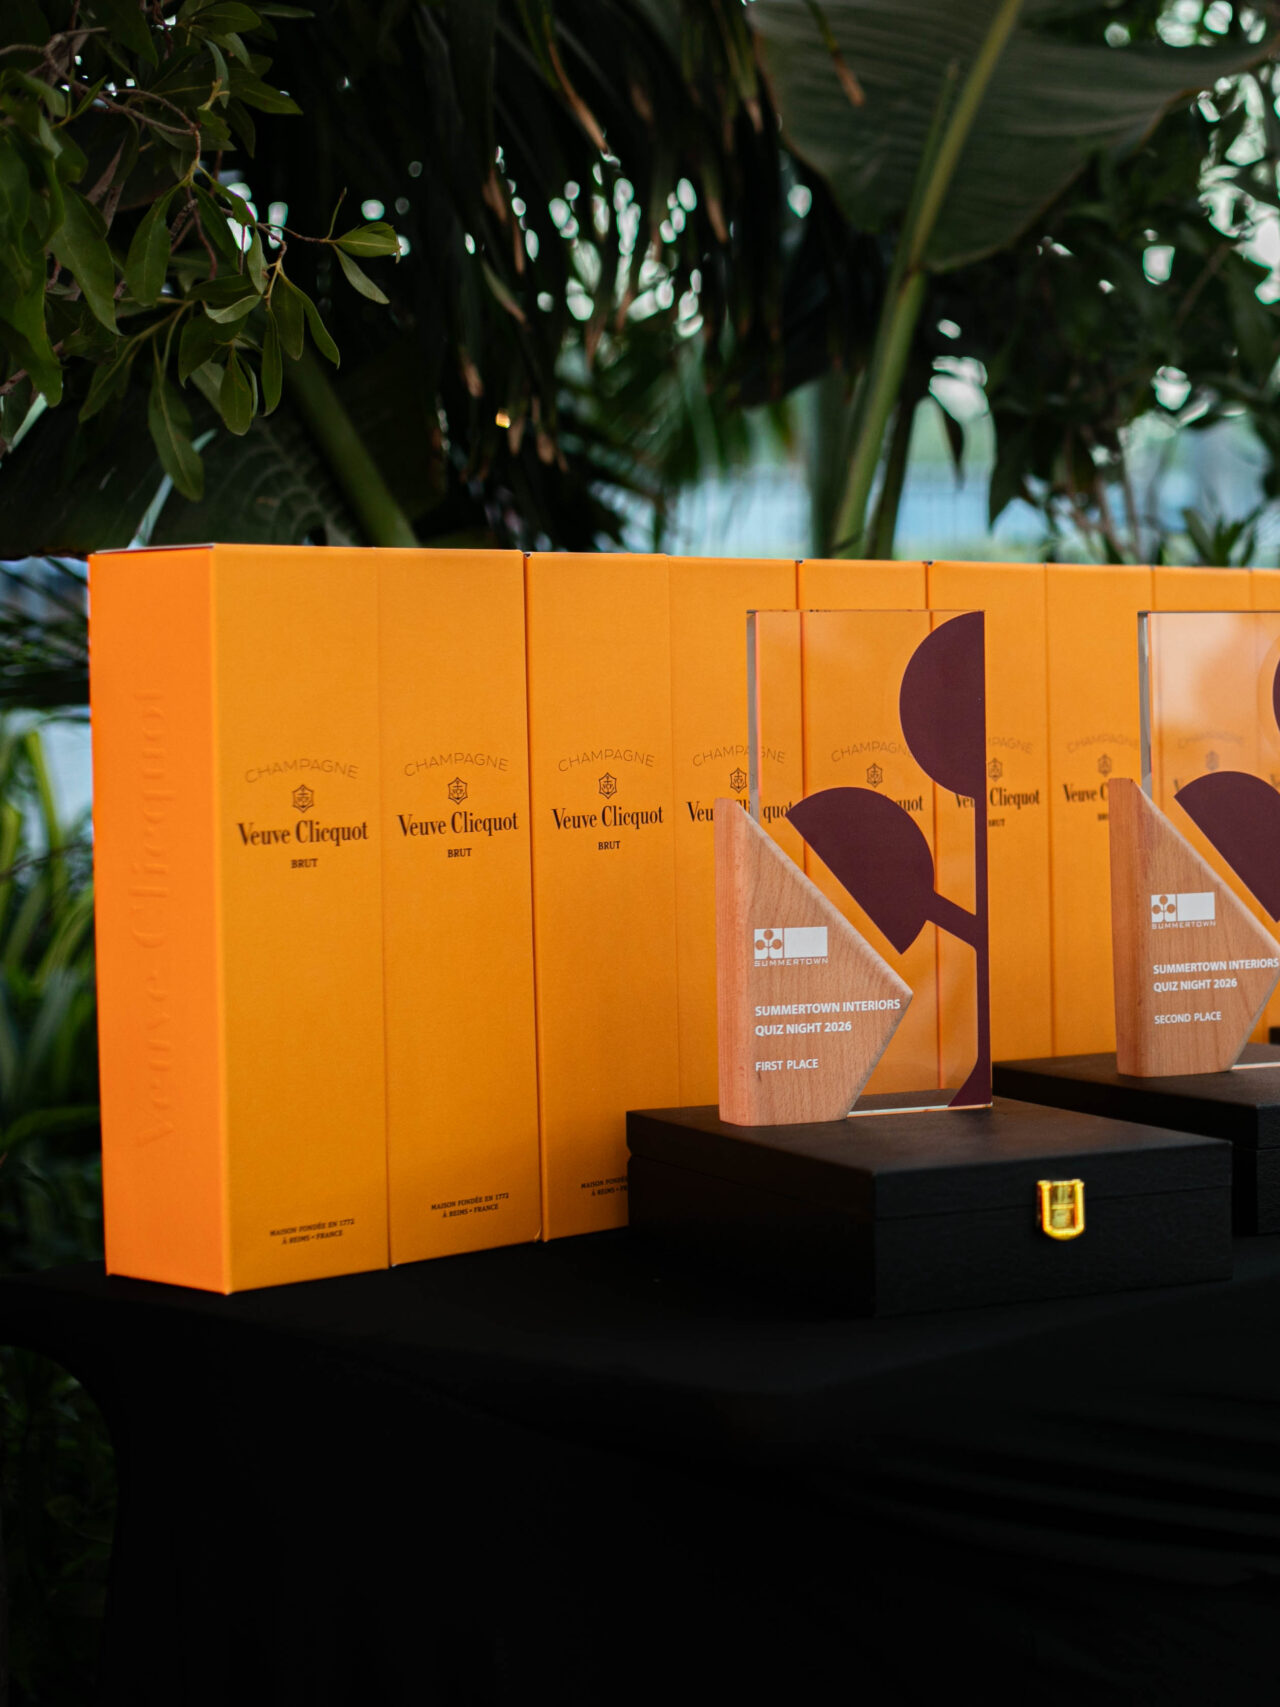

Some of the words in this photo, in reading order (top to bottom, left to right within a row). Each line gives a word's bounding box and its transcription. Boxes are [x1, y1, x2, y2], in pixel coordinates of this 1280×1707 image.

[831, 741, 912, 762] CHAMPAGN
[404, 752, 509, 776] CHAMPAGNE
[558, 749, 655, 772] CHAMPAGNE
[245, 758, 360, 783] CHAMPAGNE
[552, 808, 597, 830] Veuve
[601, 805, 664, 830] Clicquot
[686, 801, 714, 822] Veu
[397, 814, 446, 837] Veuve
[451, 811, 519, 837] Clicquot
[237, 822, 290, 846] Veuve
[296, 820, 368, 847] Clicquot
[447, 848, 472, 858] BRUT
[598, 840, 621, 850] BRUT
[291, 858, 318, 869] BRUT
[1151, 920, 1216, 930] SUMMERTOWN
[754, 958, 829, 967] SUMMERTOWN
[1153, 961, 1226, 975] SUMMERTOWN
[1229, 958, 1279, 970] INTERIORS
[1153, 981, 1178, 993] QUIZ
[1180, 979, 1211, 990] NIGHT
[1213, 978, 1238, 988] 2026
[755, 1002, 840, 1016] SUMMERTOWN
[842, 999, 901, 1012] INTERIORS
[1154, 1013, 1191, 1024] SECOND
[1194, 1011, 1222, 1022] PLACE
[755, 1024, 784, 1036] QUIZ
[786, 1022, 822, 1034] NIGHT
[824, 1021, 852, 1032] 2026
[755, 1060, 783, 1072] FIRST
[786, 1059, 819, 1070] PLACE
